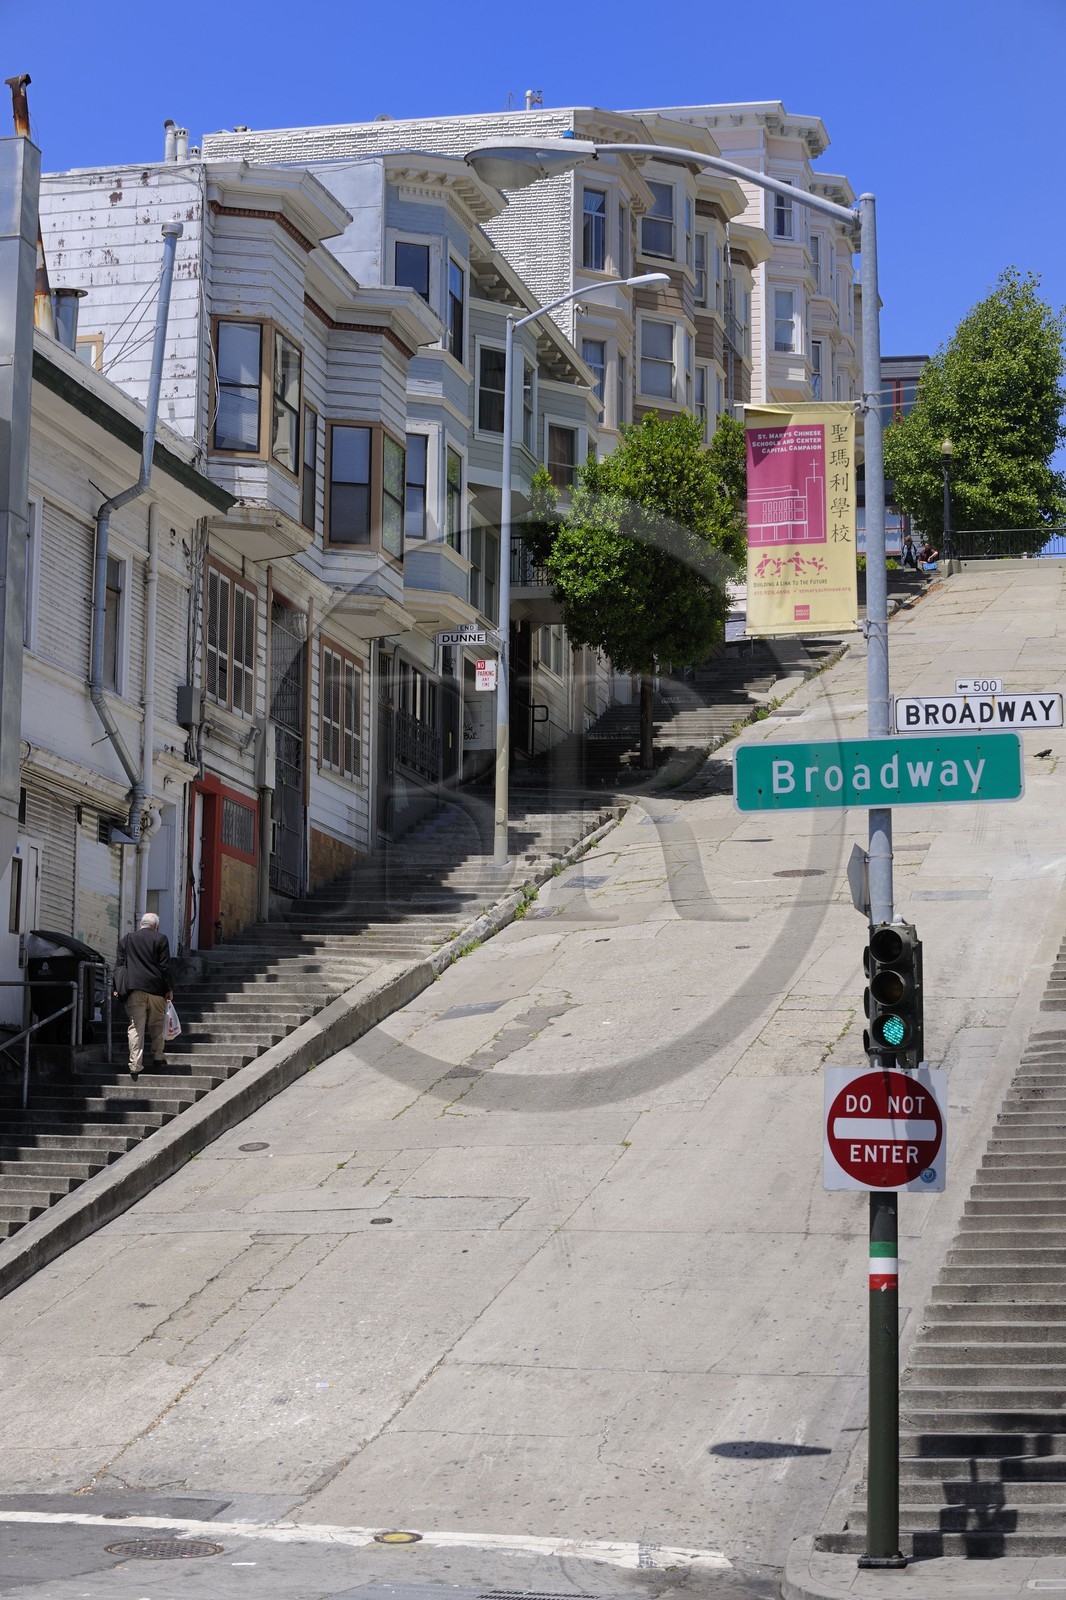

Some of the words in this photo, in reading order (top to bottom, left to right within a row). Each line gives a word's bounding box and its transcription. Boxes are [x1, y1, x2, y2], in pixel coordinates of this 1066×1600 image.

[829, 424, 852, 543] 聖瑪利學校
[442, 634, 484, 642] DUNNE
[477, 661, 484, 669] NO
[973, 681, 997, 692] 500
[906, 700, 1055, 725] BROADWAY
[772, 754, 986, 794] Broadway
[846, 1094, 871, 1113] DO
[888, 1096, 925, 1114] NOT
[850, 1144, 918, 1164] ENTER
